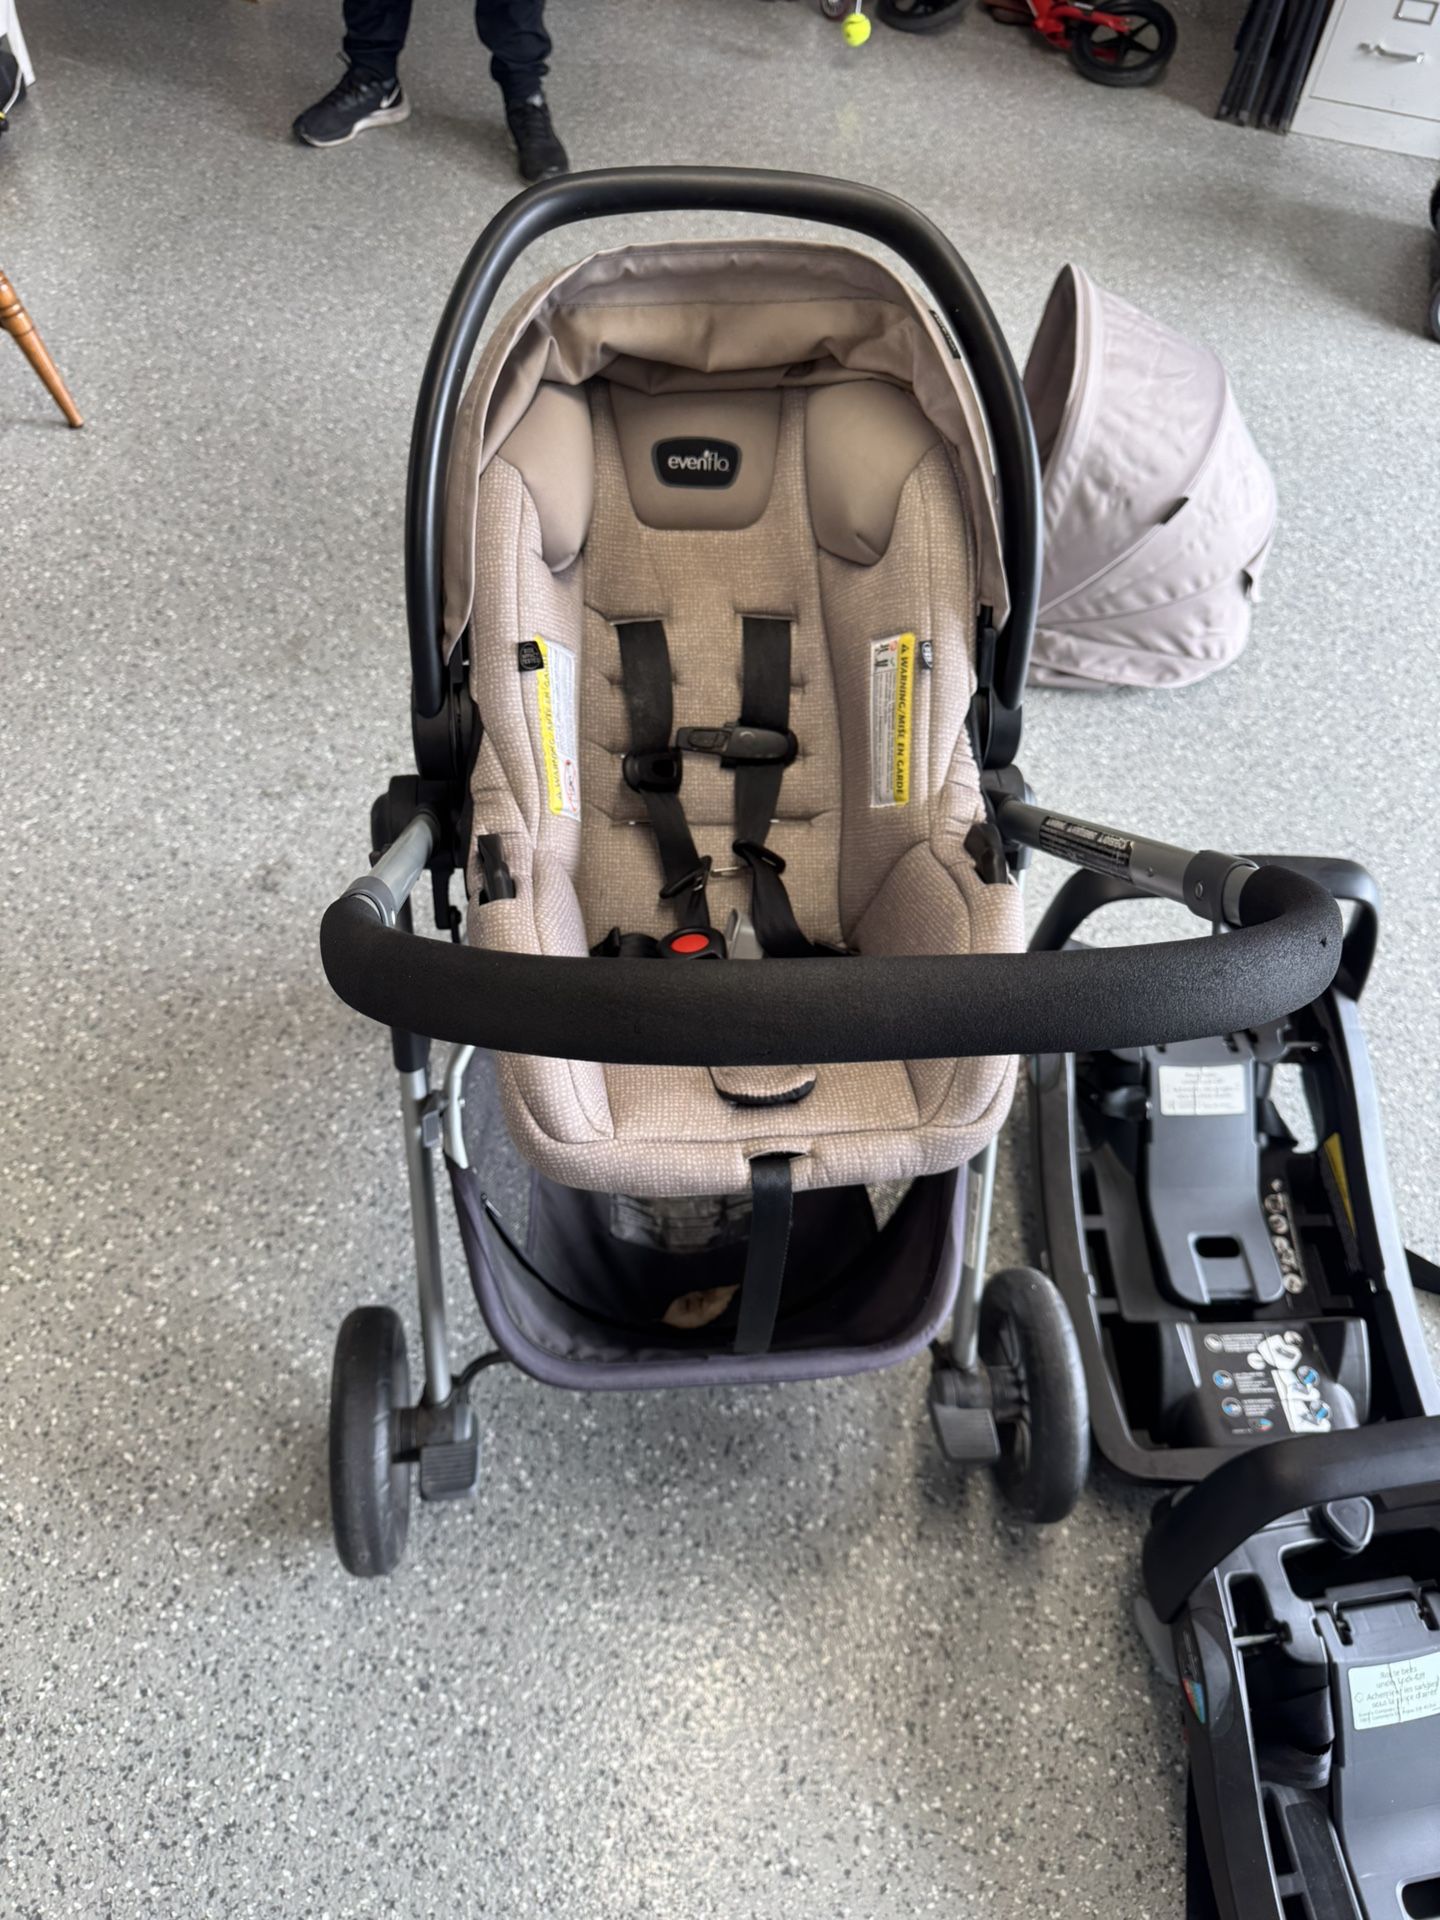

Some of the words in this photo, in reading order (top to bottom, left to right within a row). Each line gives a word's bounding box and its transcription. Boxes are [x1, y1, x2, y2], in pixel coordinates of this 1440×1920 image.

[668, 450, 729, 471] evenflo
[897, 656, 909, 738] WARNING/MISE
[896, 742, 905, 756] EN
[895, 760, 905, 795] GARDE
